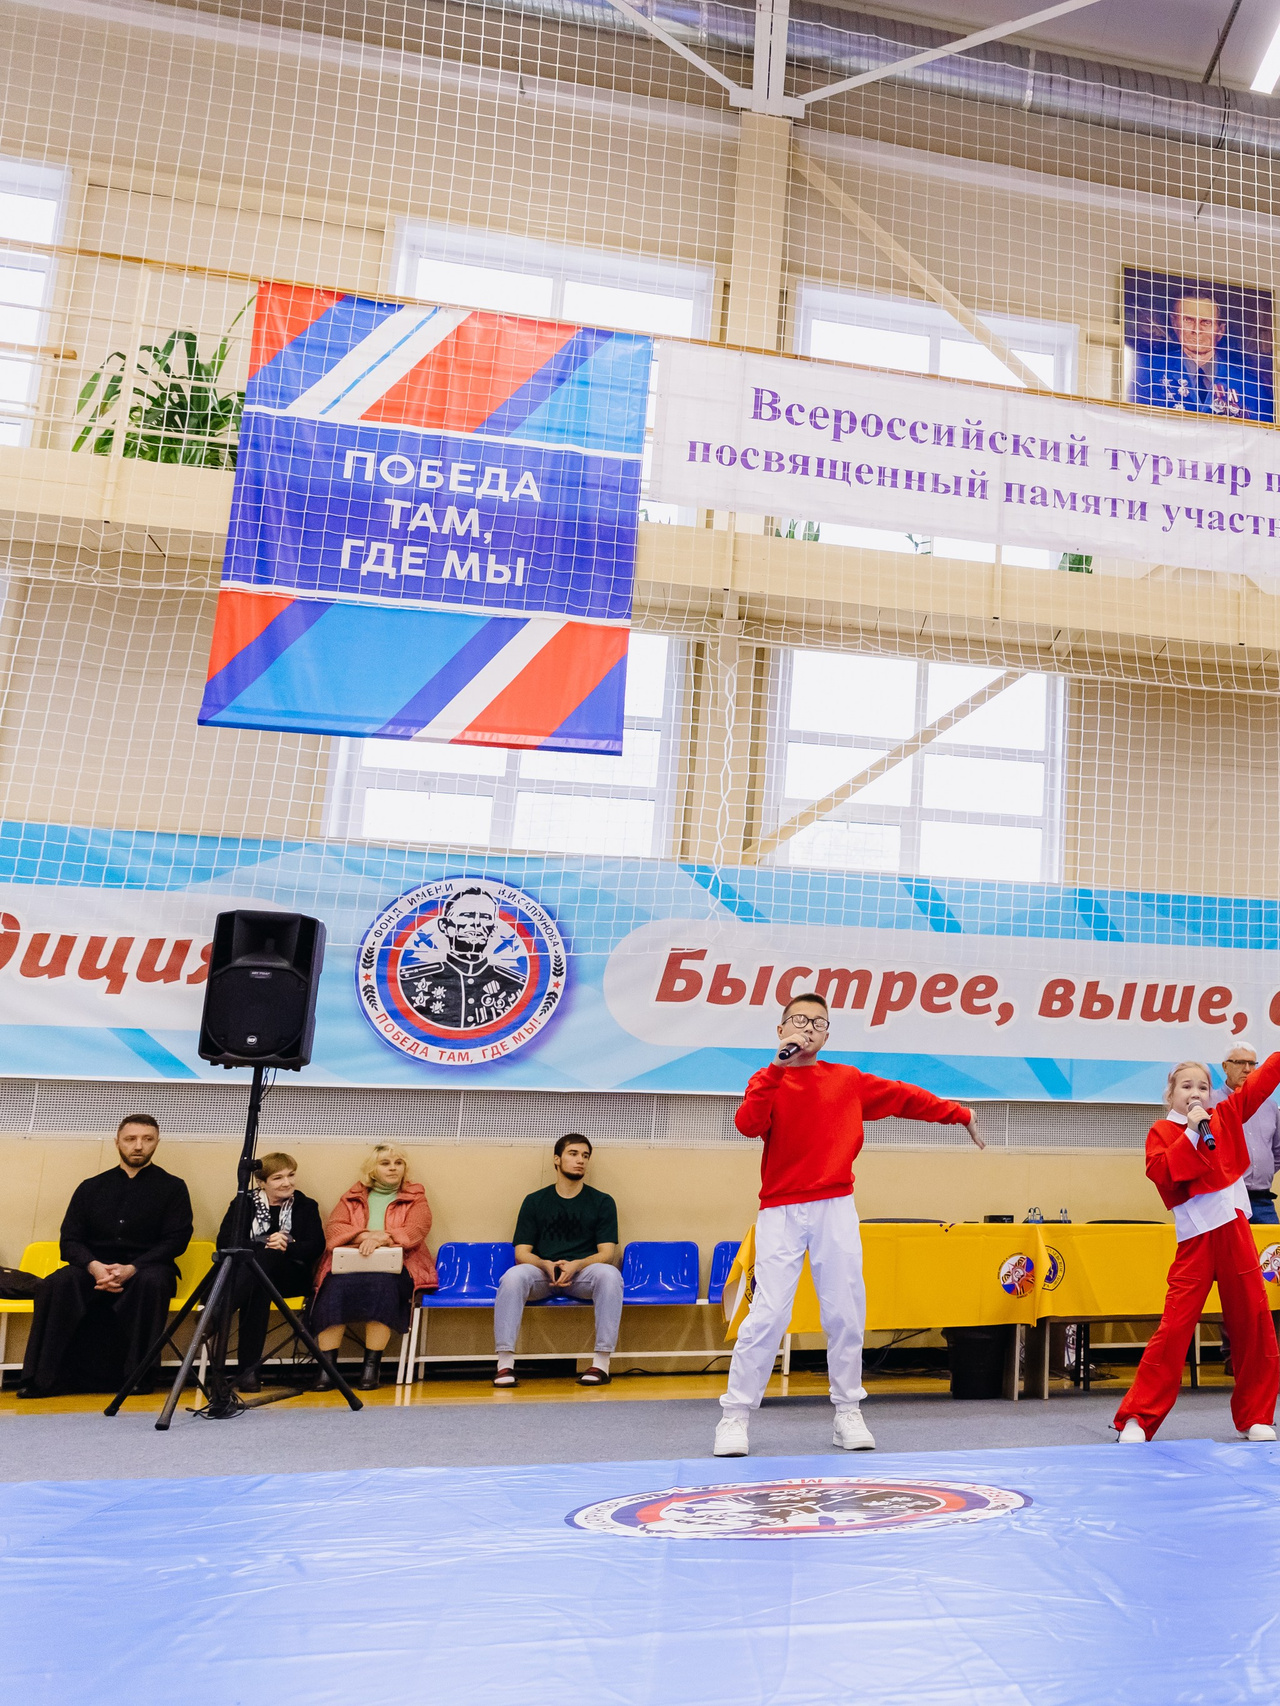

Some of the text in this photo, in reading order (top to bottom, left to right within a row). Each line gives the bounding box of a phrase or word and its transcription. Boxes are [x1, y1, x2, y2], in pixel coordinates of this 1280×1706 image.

[749, 386, 1091, 468] Всероссийский
[1103, 447, 1251, 496] турнир
[342, 448, 543, 503] ПОБЕДА
[686, 440, 990, 501] посвященный
[1003, 480, 1149, 522] памяти
[384, 497, 493, 544] ТАМ,
[340, 538, 526, 587] ГДЕ МЫ
[374, 907, 403, 938] ФОНД
[407, 883, 454, 906] ИМЕНИ
[655, 947, 1014, 1027] Быстрее,
[1038, 977, 1249, 1034] выше,
[375, 1013, 542, 1064] ПОБЕДА ТАМ, ГДЕ МЫ!
